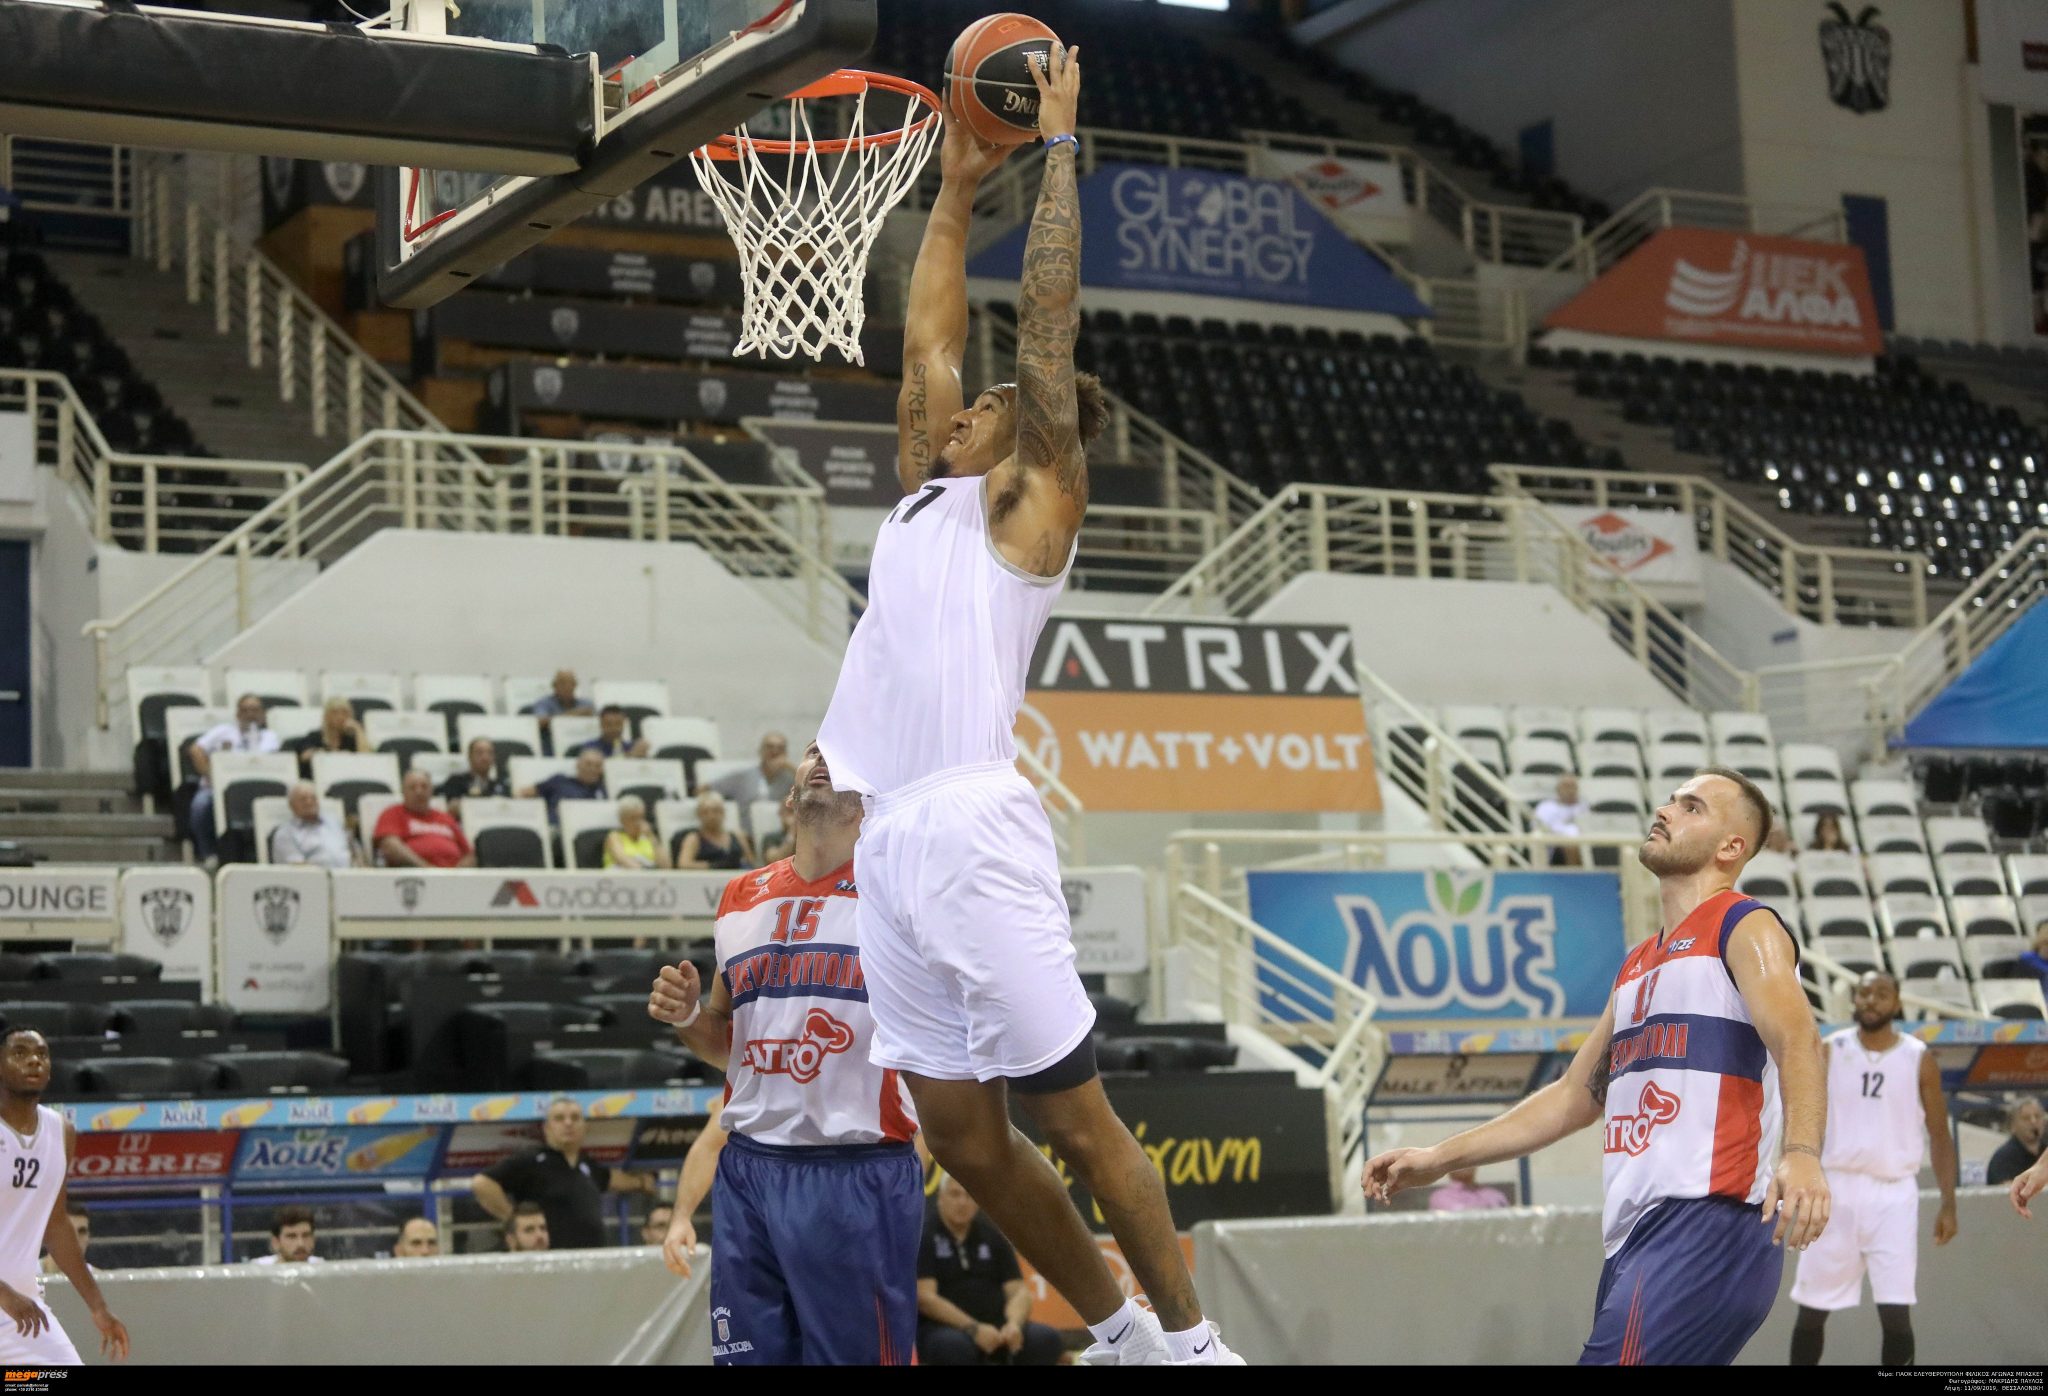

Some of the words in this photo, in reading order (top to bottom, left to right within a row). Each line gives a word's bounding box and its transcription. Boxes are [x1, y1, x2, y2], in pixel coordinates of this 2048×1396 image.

[1116, 220, 1314, 283] SYNERGY
[1040, 622, 1360, 693] ATRIX
[1077, 731, 1367, 771] WATT+VOLT
[770, 900, 835, 943] 15
[1861, 1071, 1885, 1098] 12
[12, 1157, 40, 1189] 32
